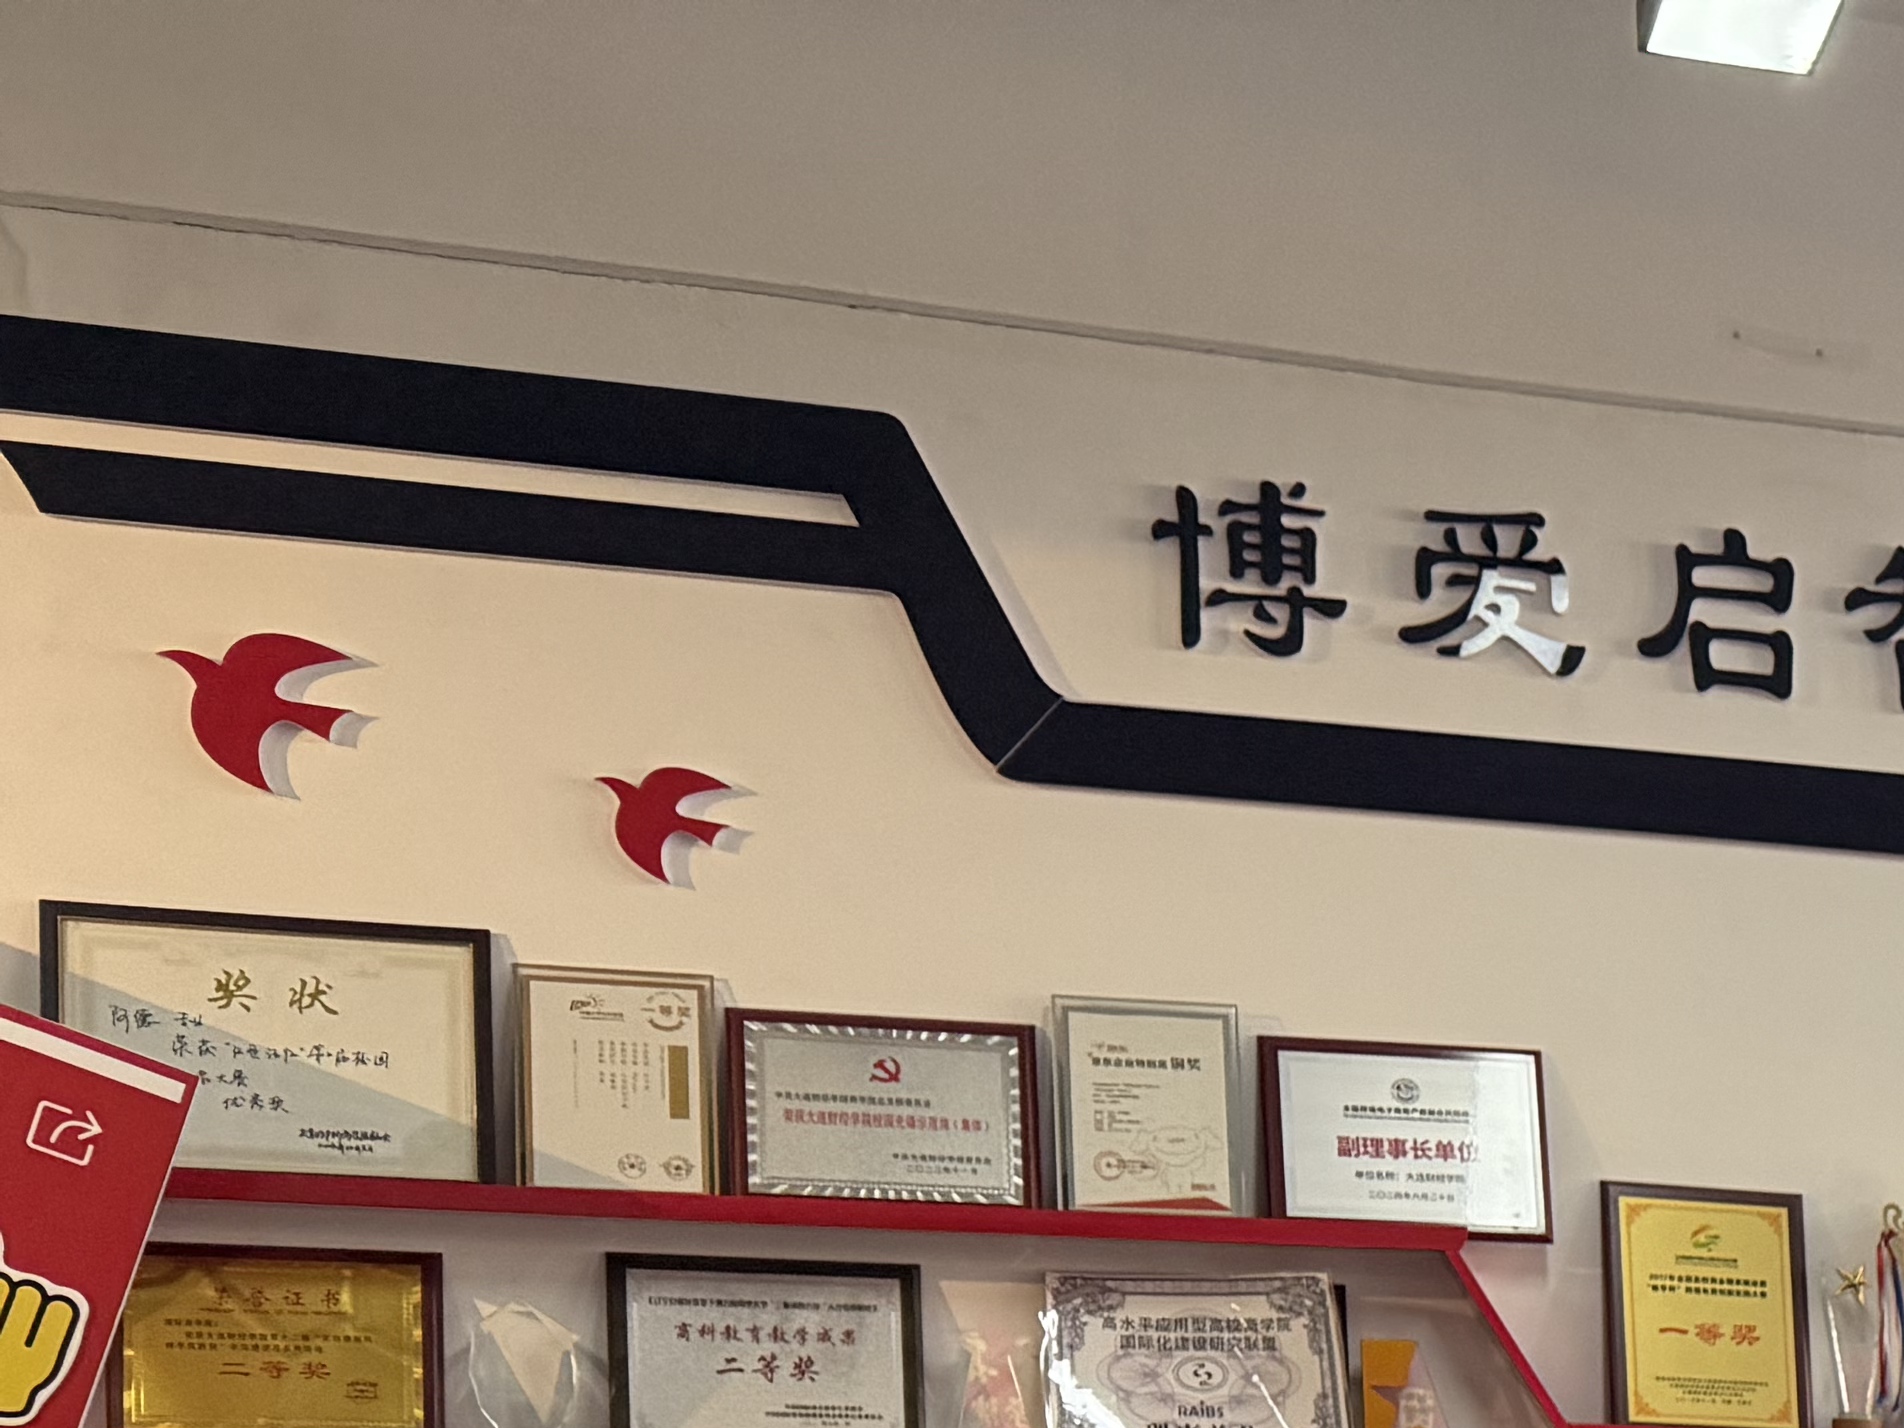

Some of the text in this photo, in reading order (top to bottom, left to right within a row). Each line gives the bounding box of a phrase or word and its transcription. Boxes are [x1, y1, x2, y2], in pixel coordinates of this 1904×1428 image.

[207, 967, 340, 1016] 奖状
[1336, 1134, 1480, 1164] 副理事长单位
[217, 1360, 332, 1381] 二等奖
[716, 1350, 821, 1384] 二等奖
